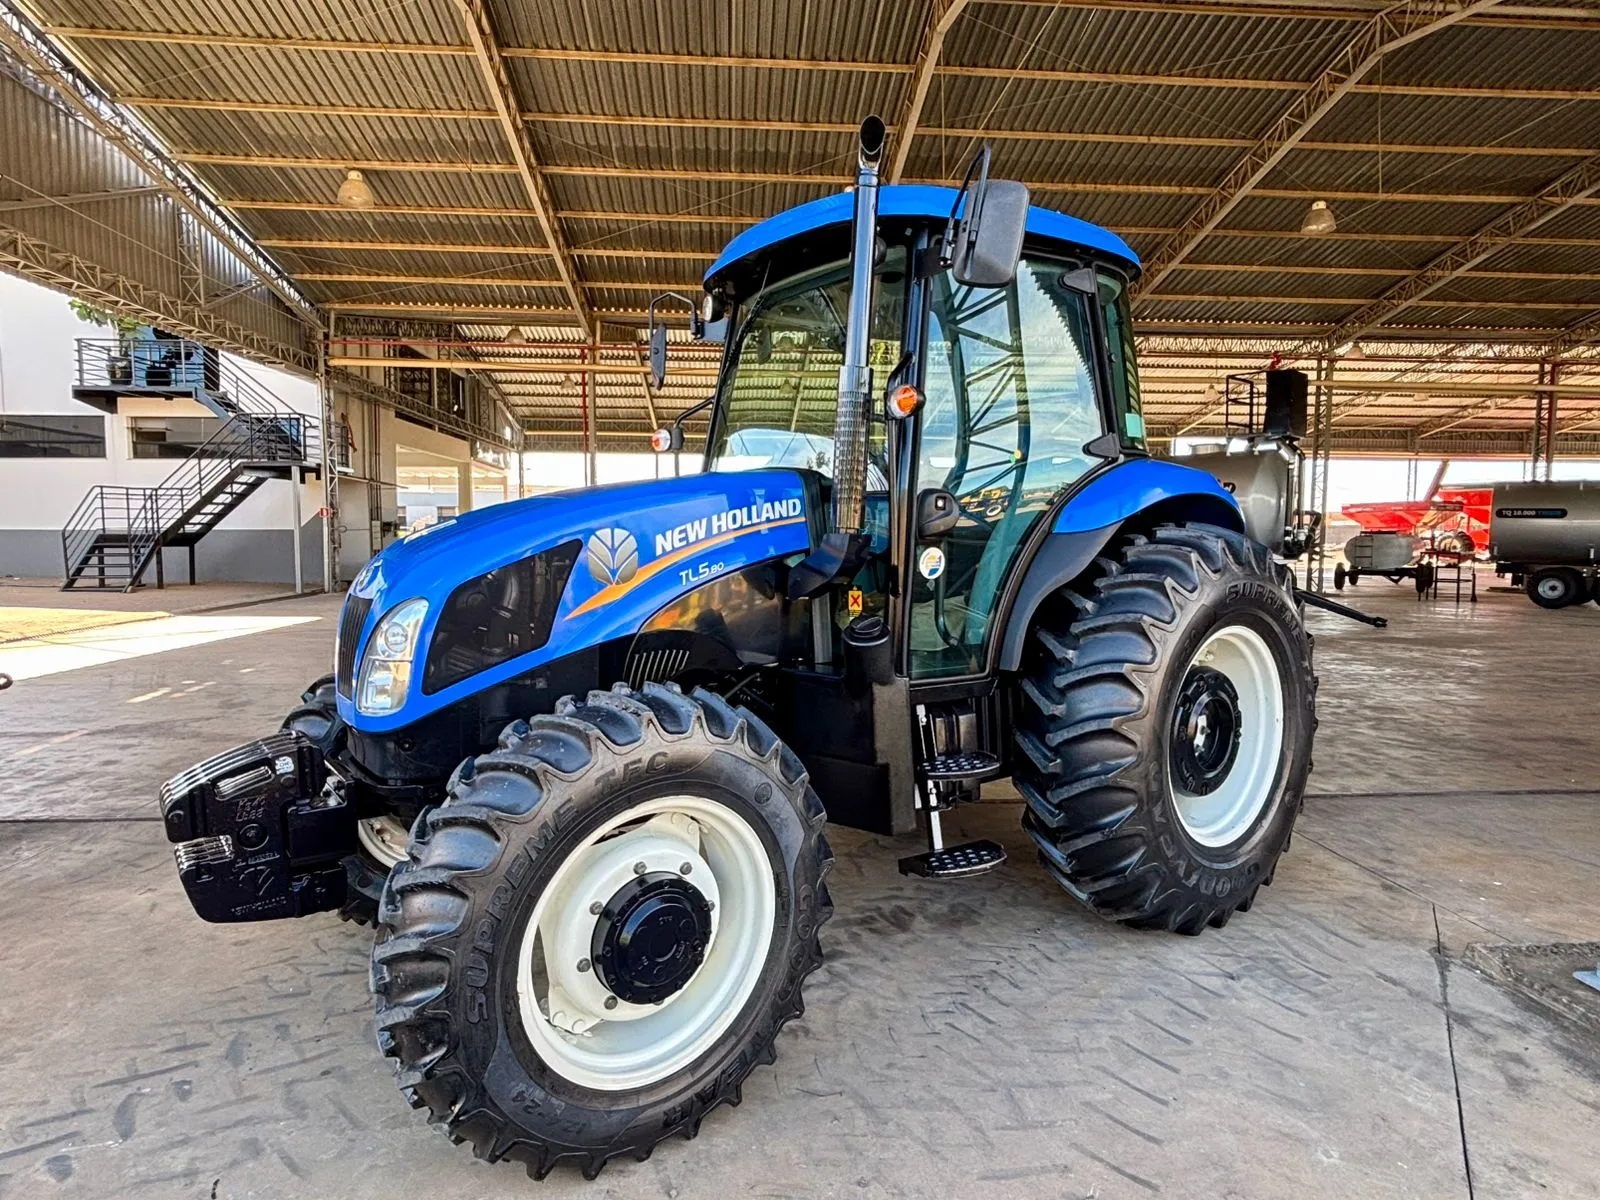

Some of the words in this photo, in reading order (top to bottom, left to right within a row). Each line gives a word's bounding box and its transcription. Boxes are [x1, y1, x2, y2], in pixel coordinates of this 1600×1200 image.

[655, 524, 708, 557] NEW
[712, 498, 802, 534] HOLLAND
[465, 795, 579, 1025] SUPREME
